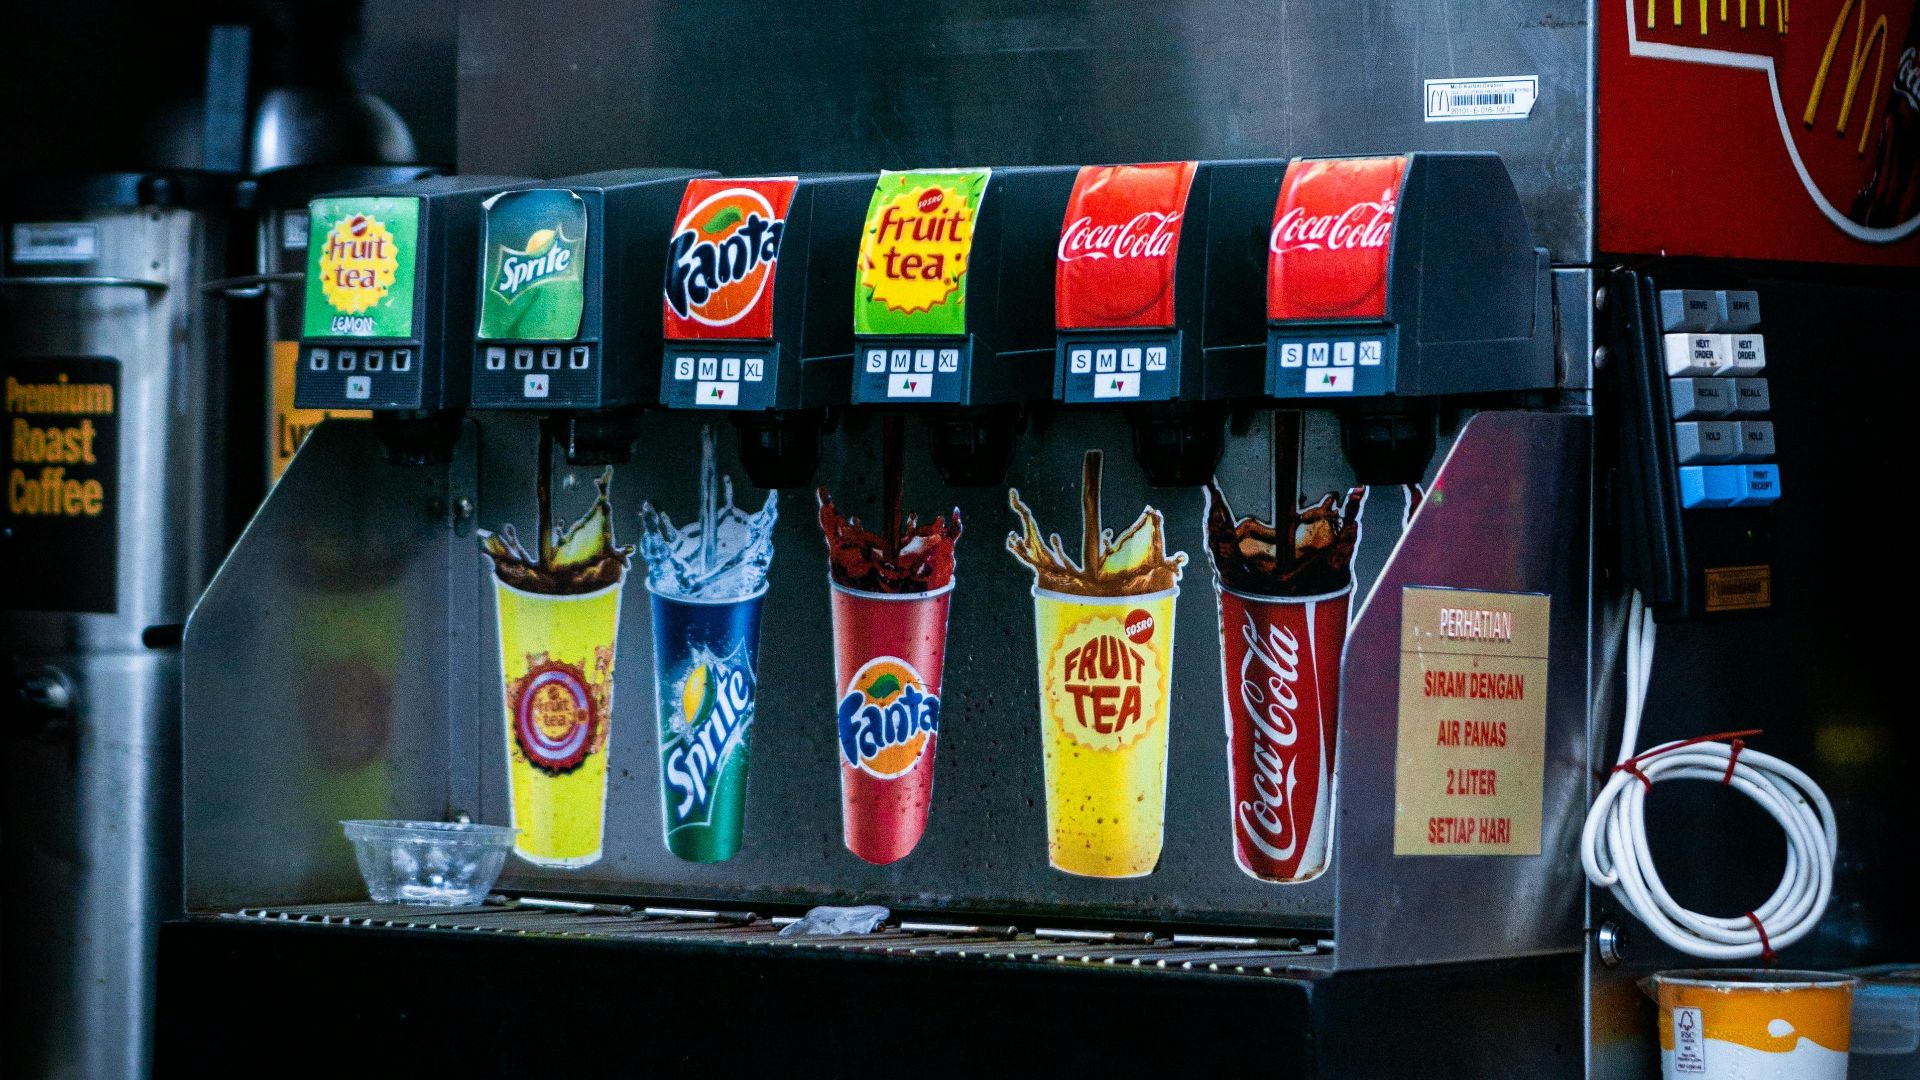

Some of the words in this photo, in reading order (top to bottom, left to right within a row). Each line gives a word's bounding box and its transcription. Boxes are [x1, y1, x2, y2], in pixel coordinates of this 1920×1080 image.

[877, 207, 966, 244] fruit
[1058, 211, 1184, 262] Coca-Cola
[1270, 202, 1393, 254] Coca-Cola
[329, 232, 388, 261] fruit
[334, 264, 376, 288] tea
[499, 245, 571, 293] Sprite
[665, 213, 784, 318] Fanta
[883, 247, 944, 280] tea
[331, 315, 374, 333] LEMON
[1286, 348, 1297, 363] S
[1311, 347, 1324, 362] M
[1338, 346, 1348, 361] L
[1361, 345, 1379, 360] XL
[1694, 350, 1714, 359] ORDER
[1695, 339, 1710, 348] NEXT
[1737, 351, 1756, 360] ORDER
[1738, 340, 1753, 349] NEXT
[679, 362, 690, 376] S
[702, 362, 714, 376] M
[726, 362, 735, 376] L
[745, 362, 763, 377] XL
[872, 354, 882, 368] S
[894, 354, 907, 368] M
[920, 354, 929, 368] L
[939, 353, 957, 368] XL
[1076, 354, 1087, 368] S
[1100, 354, 1113, 368] M
[1126, 352, 1135, 367] L
[1147, 351, 1165, 366] XL
[6, 373, 114, 415] Premium
[12, 417, 97, 464] Roast
[8, 466, 104, 516] Coffee
[1125, 616, 1153, 637] SOSRO
[1440, 608, 1511, 640] PERHATIAN
[1064, 635, 1146, 684] FRUIT
[1424, 670, 1466, 698] SIRAM
[1470, 673, 1524, 700] DENGAN
[1064, 684, 1142, 734] TEA
[838, 684, 940, 766] Fanta
[1239, 609, 1299, 861] Coca-Cola
[1437, 720, 1460, 746] AIR
[1464, 721, 1507, 748] PANAS
[667, 665, 750, 819] Sprite
[1446, 769, 1454, 795] 2
[1458, 769, 1497, 796] LITER
[1428, 817, 1475, 844] SETIAP
[1479, 817, 1511, 844] HARI
